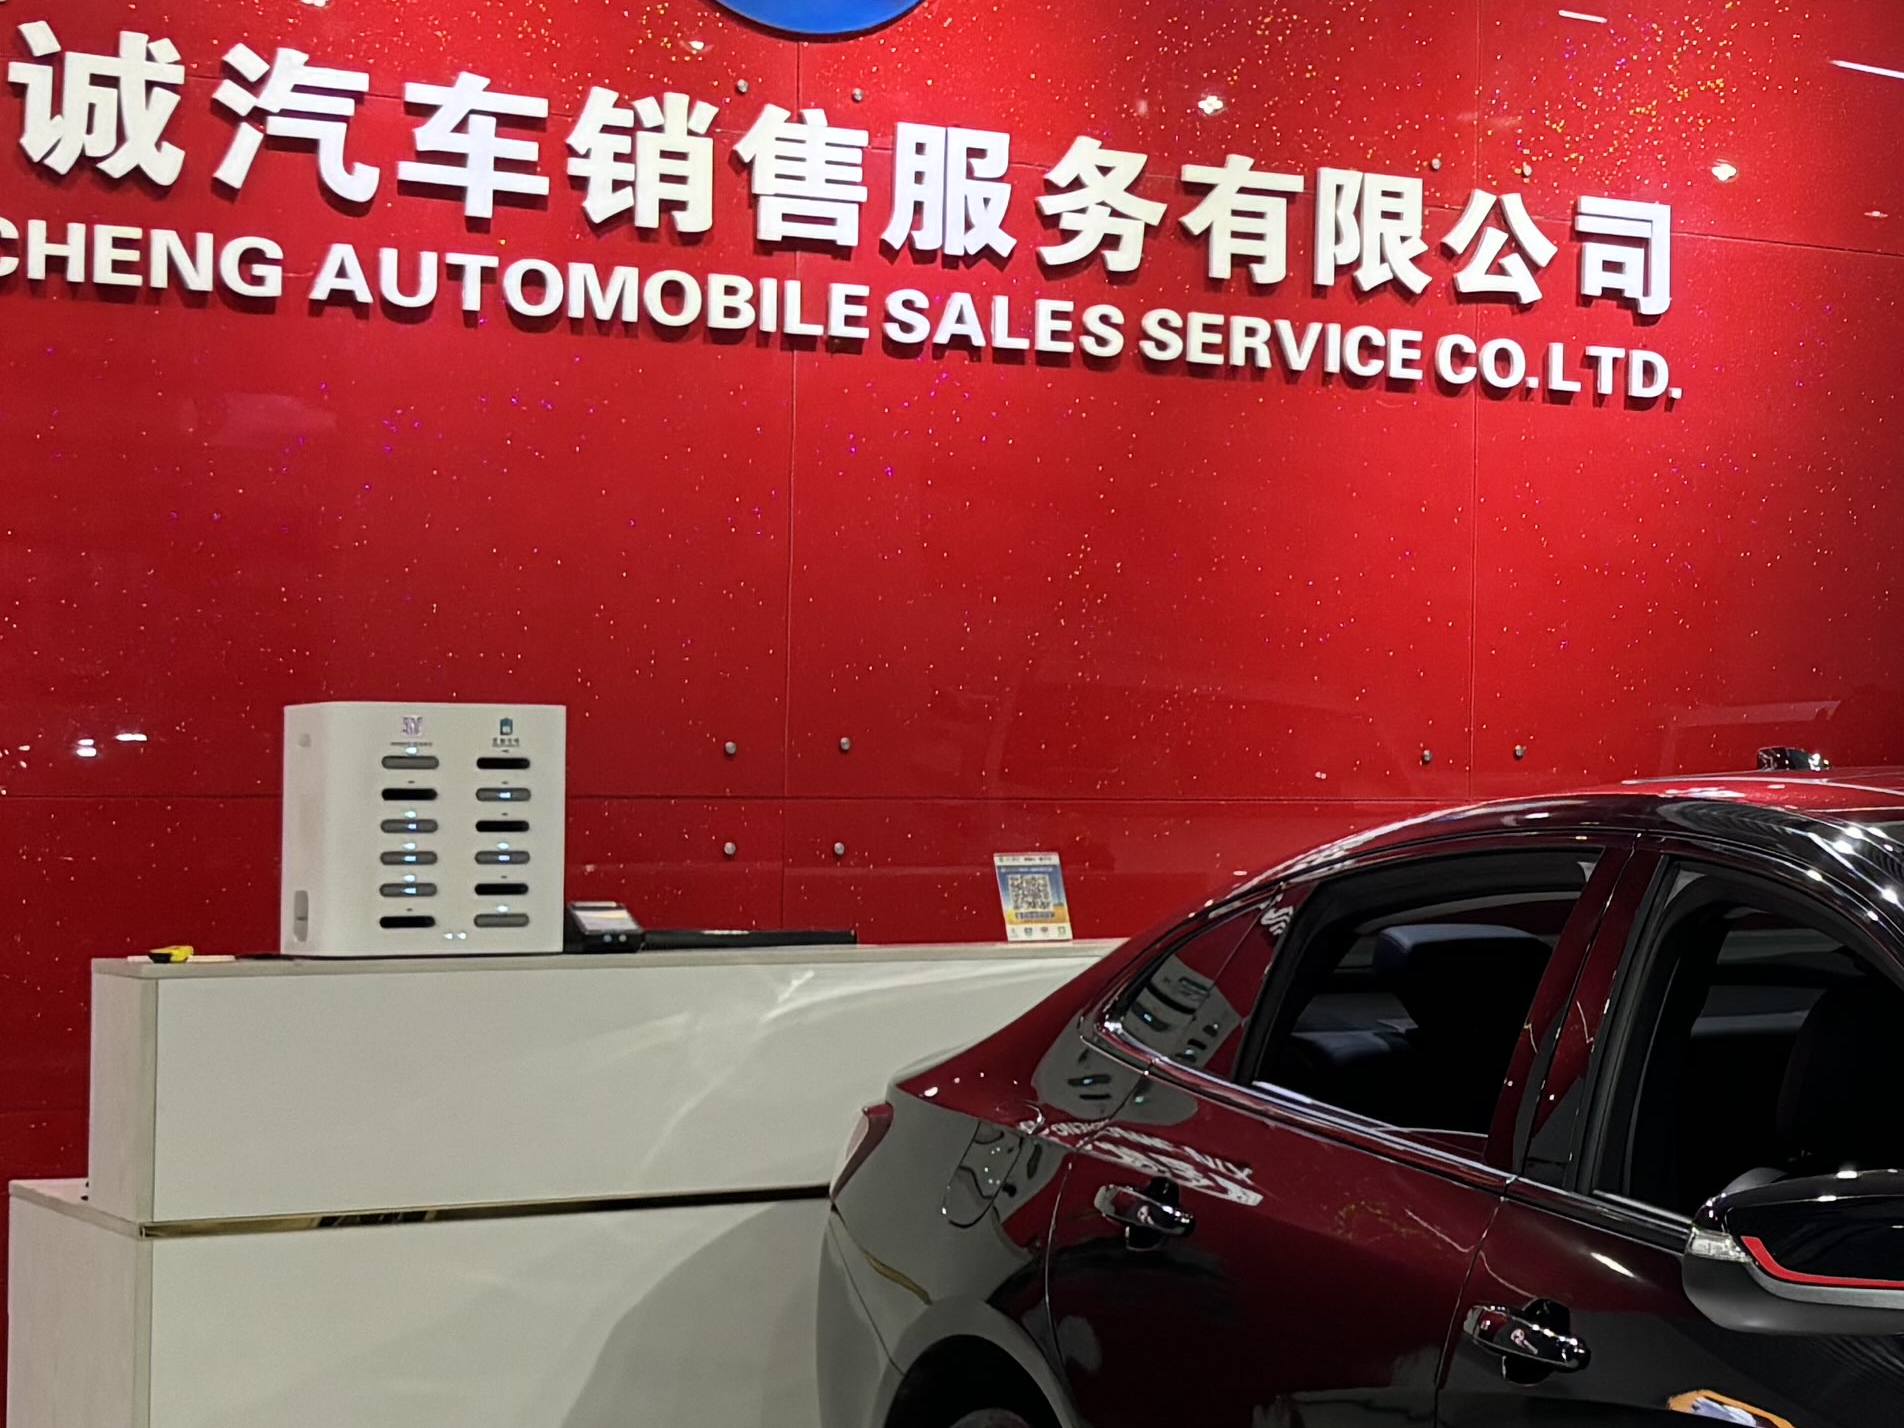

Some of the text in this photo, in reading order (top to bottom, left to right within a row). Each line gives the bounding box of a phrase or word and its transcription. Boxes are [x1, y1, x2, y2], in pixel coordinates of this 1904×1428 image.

[8, 20, 1672, 316] 诚汽车销售服务有限公司
[309, 243, 869, 339] AUTOMOBILE
[882, 285, 1125, 358] SALES
[1139, 308, 1423, 381] SERVICE
